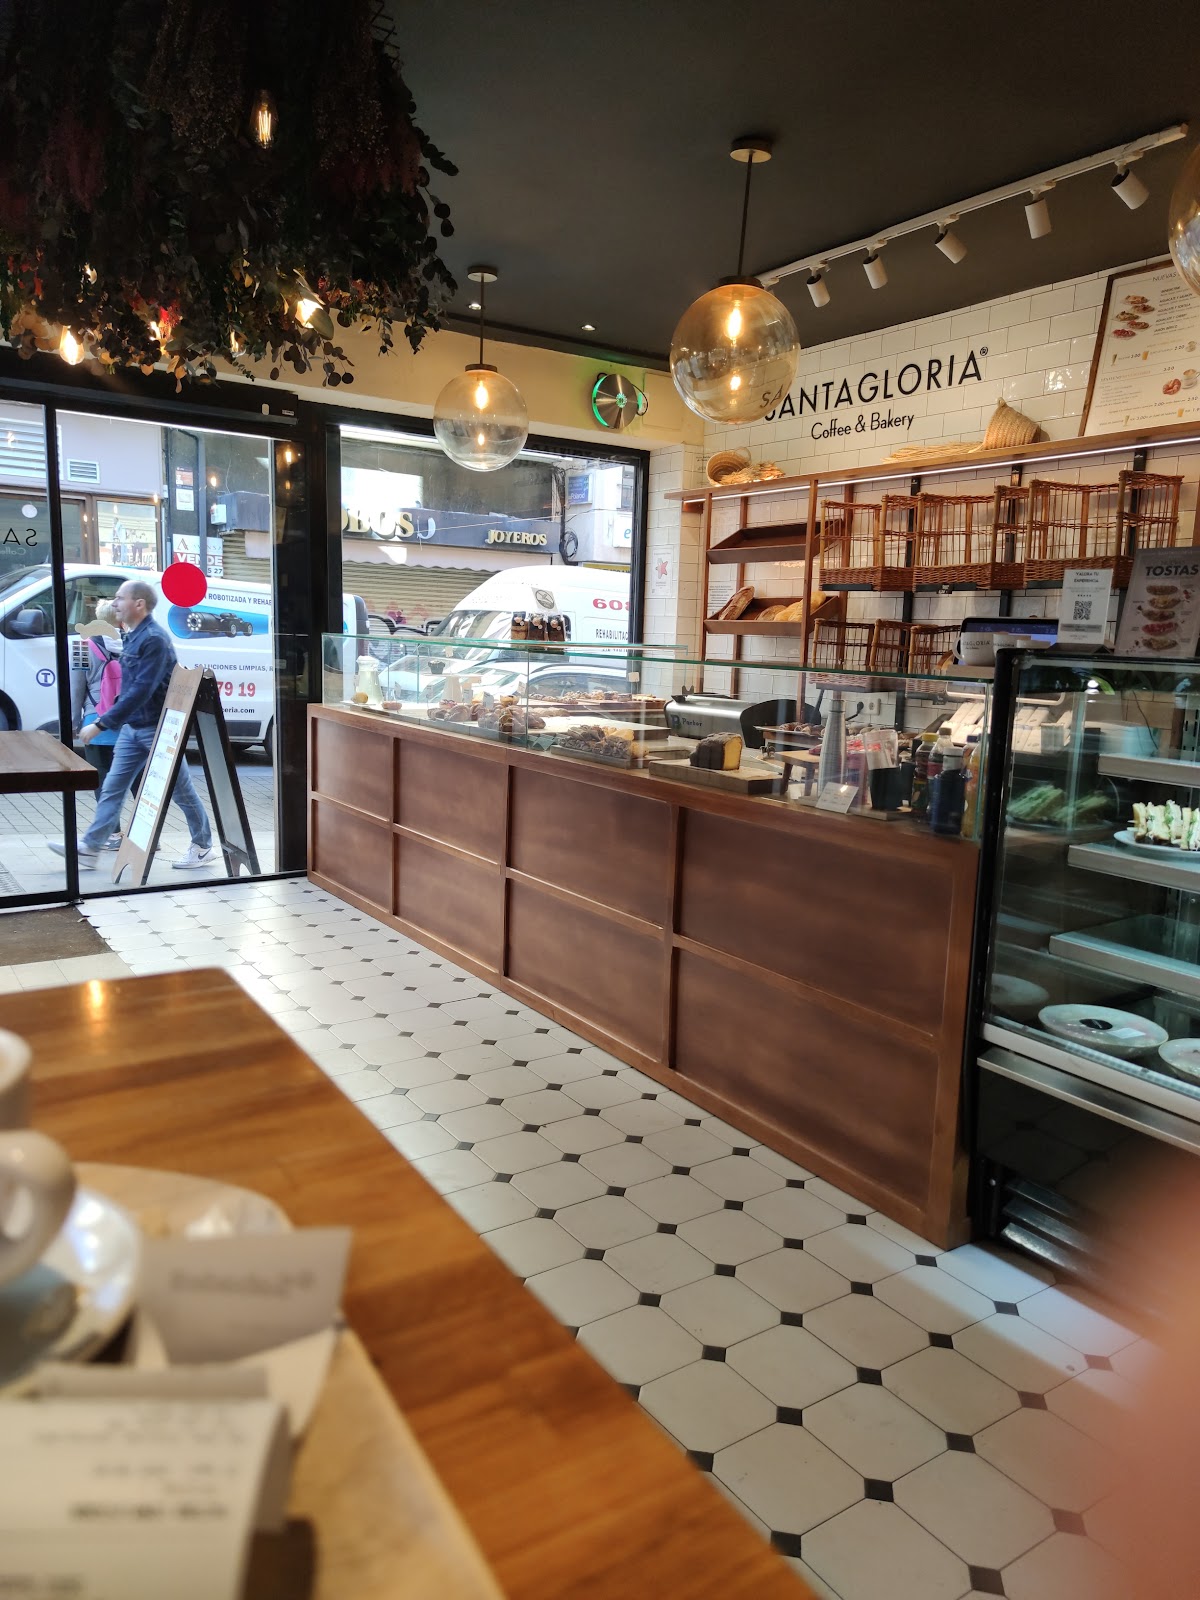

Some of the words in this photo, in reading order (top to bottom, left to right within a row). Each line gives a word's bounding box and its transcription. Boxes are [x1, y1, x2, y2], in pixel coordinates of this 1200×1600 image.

[811, 419, 851, 439] Coffee
[854, 415, 866, 433] &
[870, 409, 915, 430] Bakery
[485, 529, 547, 546] JOYEROS
[1145, 564, 1199, 576] TOSTAS
[208, 593, 246, 604] ROBOTIZADA
[238, 681, 256, 697] 19
